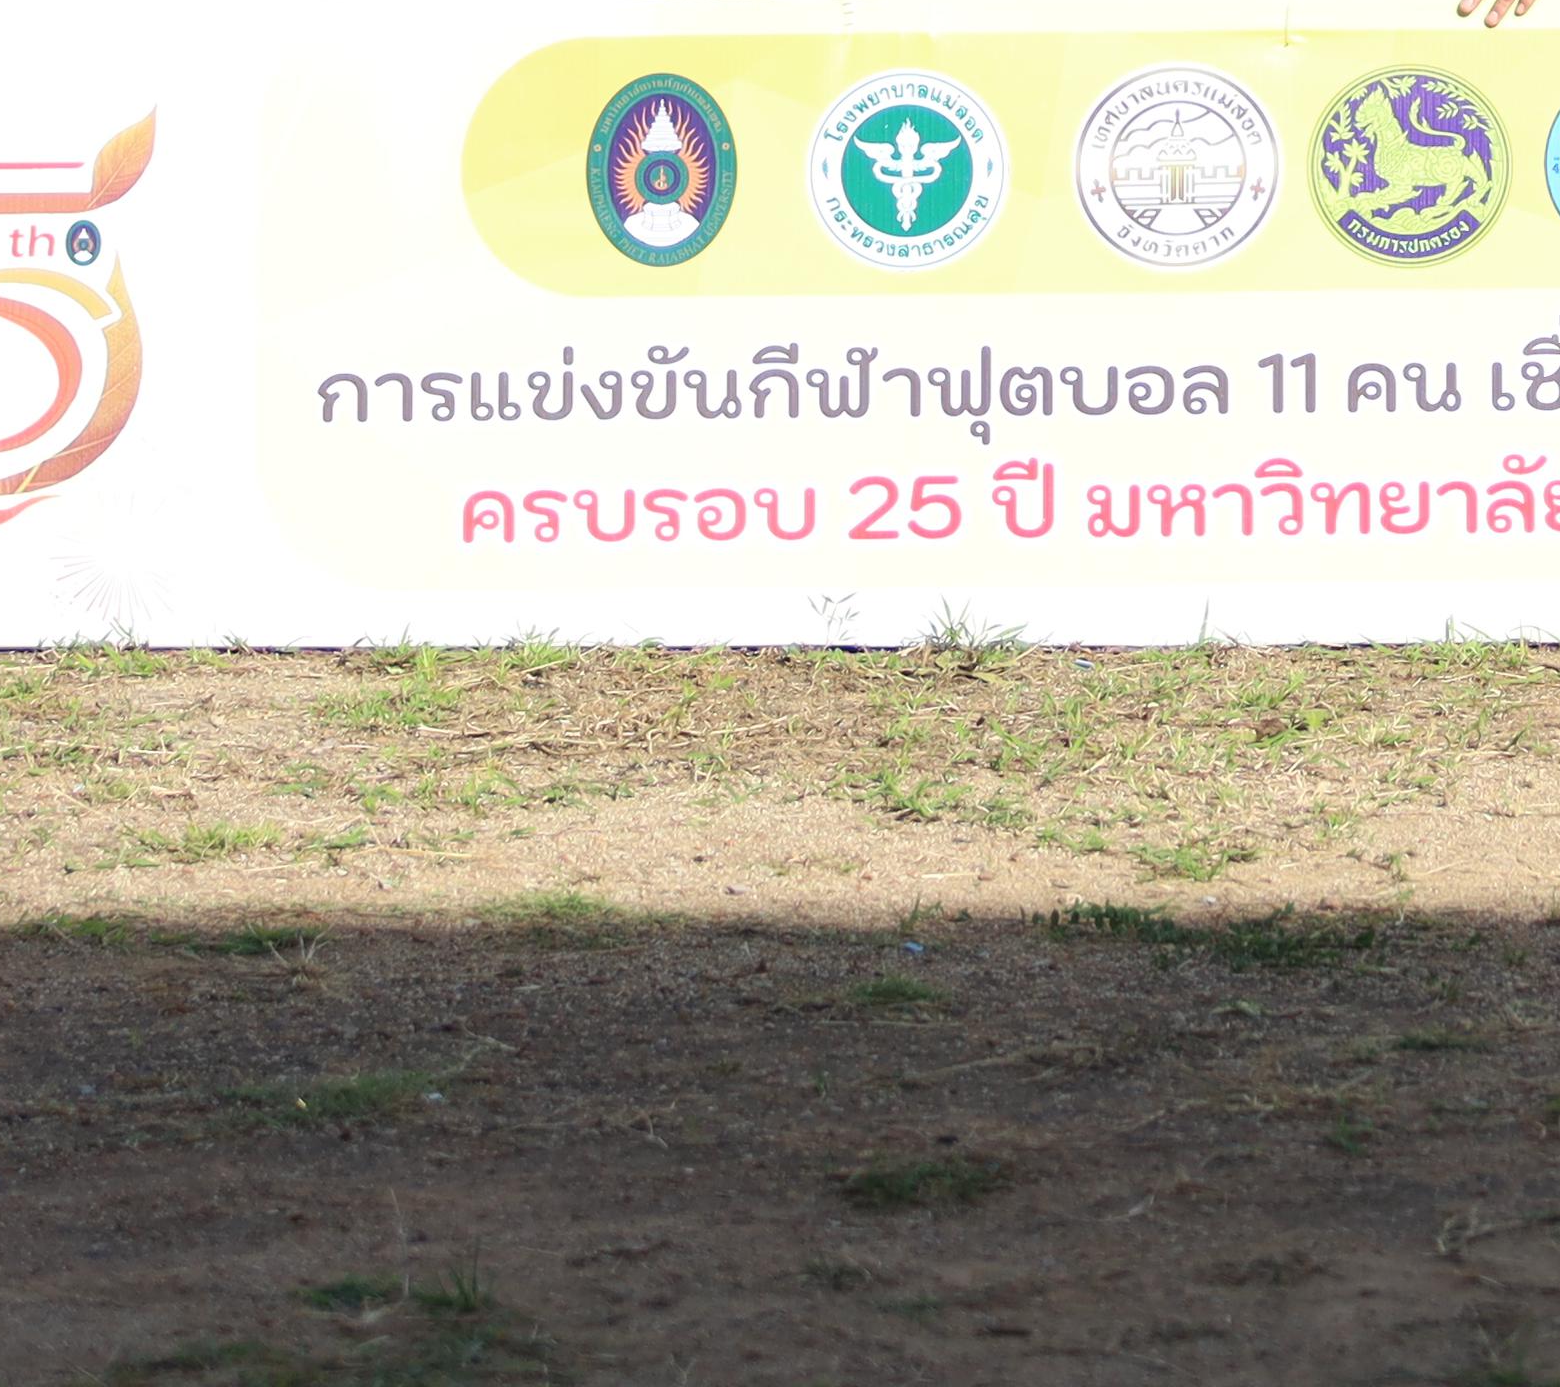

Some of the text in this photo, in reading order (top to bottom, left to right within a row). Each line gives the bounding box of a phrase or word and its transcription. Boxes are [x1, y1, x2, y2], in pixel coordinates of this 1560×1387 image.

[824, 82, 984, 144] โรงพยาบาลแม่สอด
[1091, 80, 1263, 150] เทศบาลนครแม่สอด
[9, 225, 56, 257] th
[826, 194, 989, 258] กระทรวงสาธารณสุข
[1116, 224, 1235, 258] จังหวัดตาก
[1347, 218, 1471, 255] กรมการปกครอง
[317, 342, 1230, 445] การแข่งขันกีฬาฟุตบอล
[1257, 352, 1317, 415] 11
[1347, 361, 1462, 414] คน
[462, 485, 817, 544] ครบรอบ
[847, 474, 963, 541] 25
[991, 456, 1056, 539] ปี
